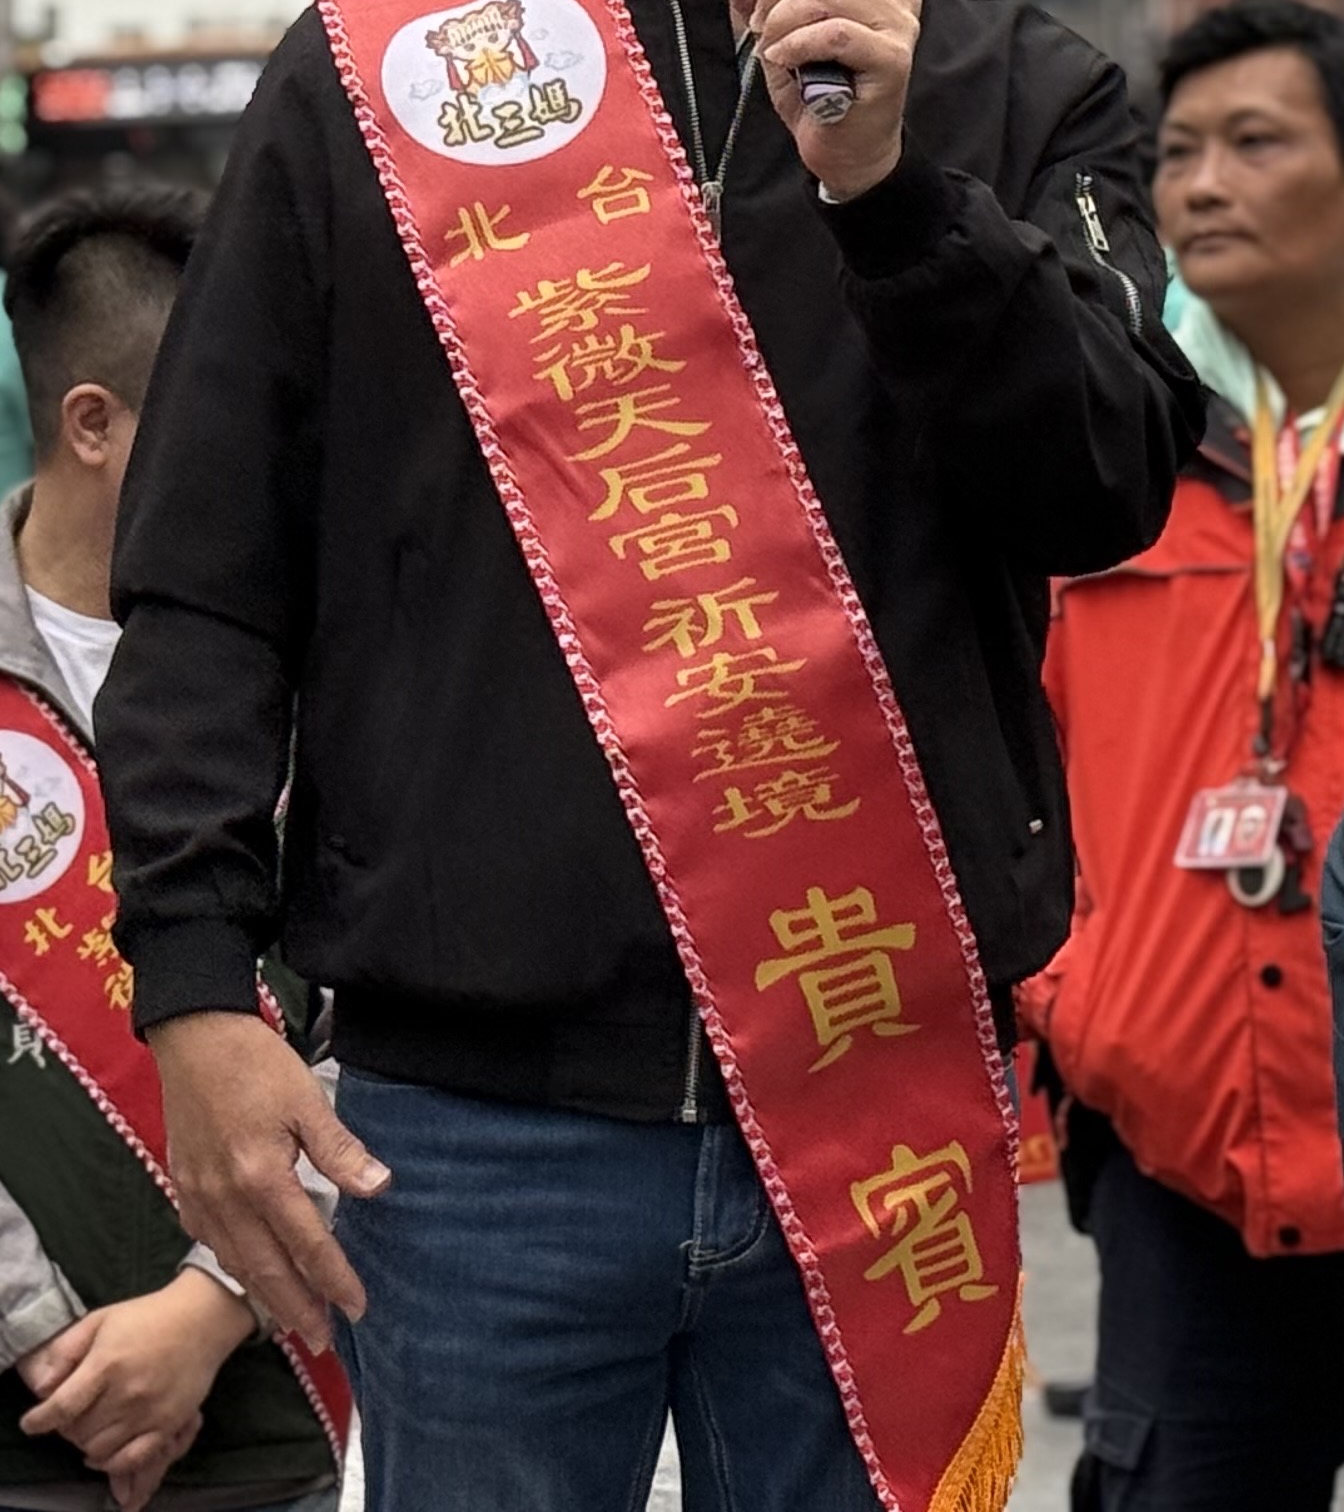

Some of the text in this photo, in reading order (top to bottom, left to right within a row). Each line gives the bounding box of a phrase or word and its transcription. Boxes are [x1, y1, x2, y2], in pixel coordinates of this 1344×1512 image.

[437, 78, 582, 149] 北三媽
[754, 885, 1000, 1335] 貴賓
